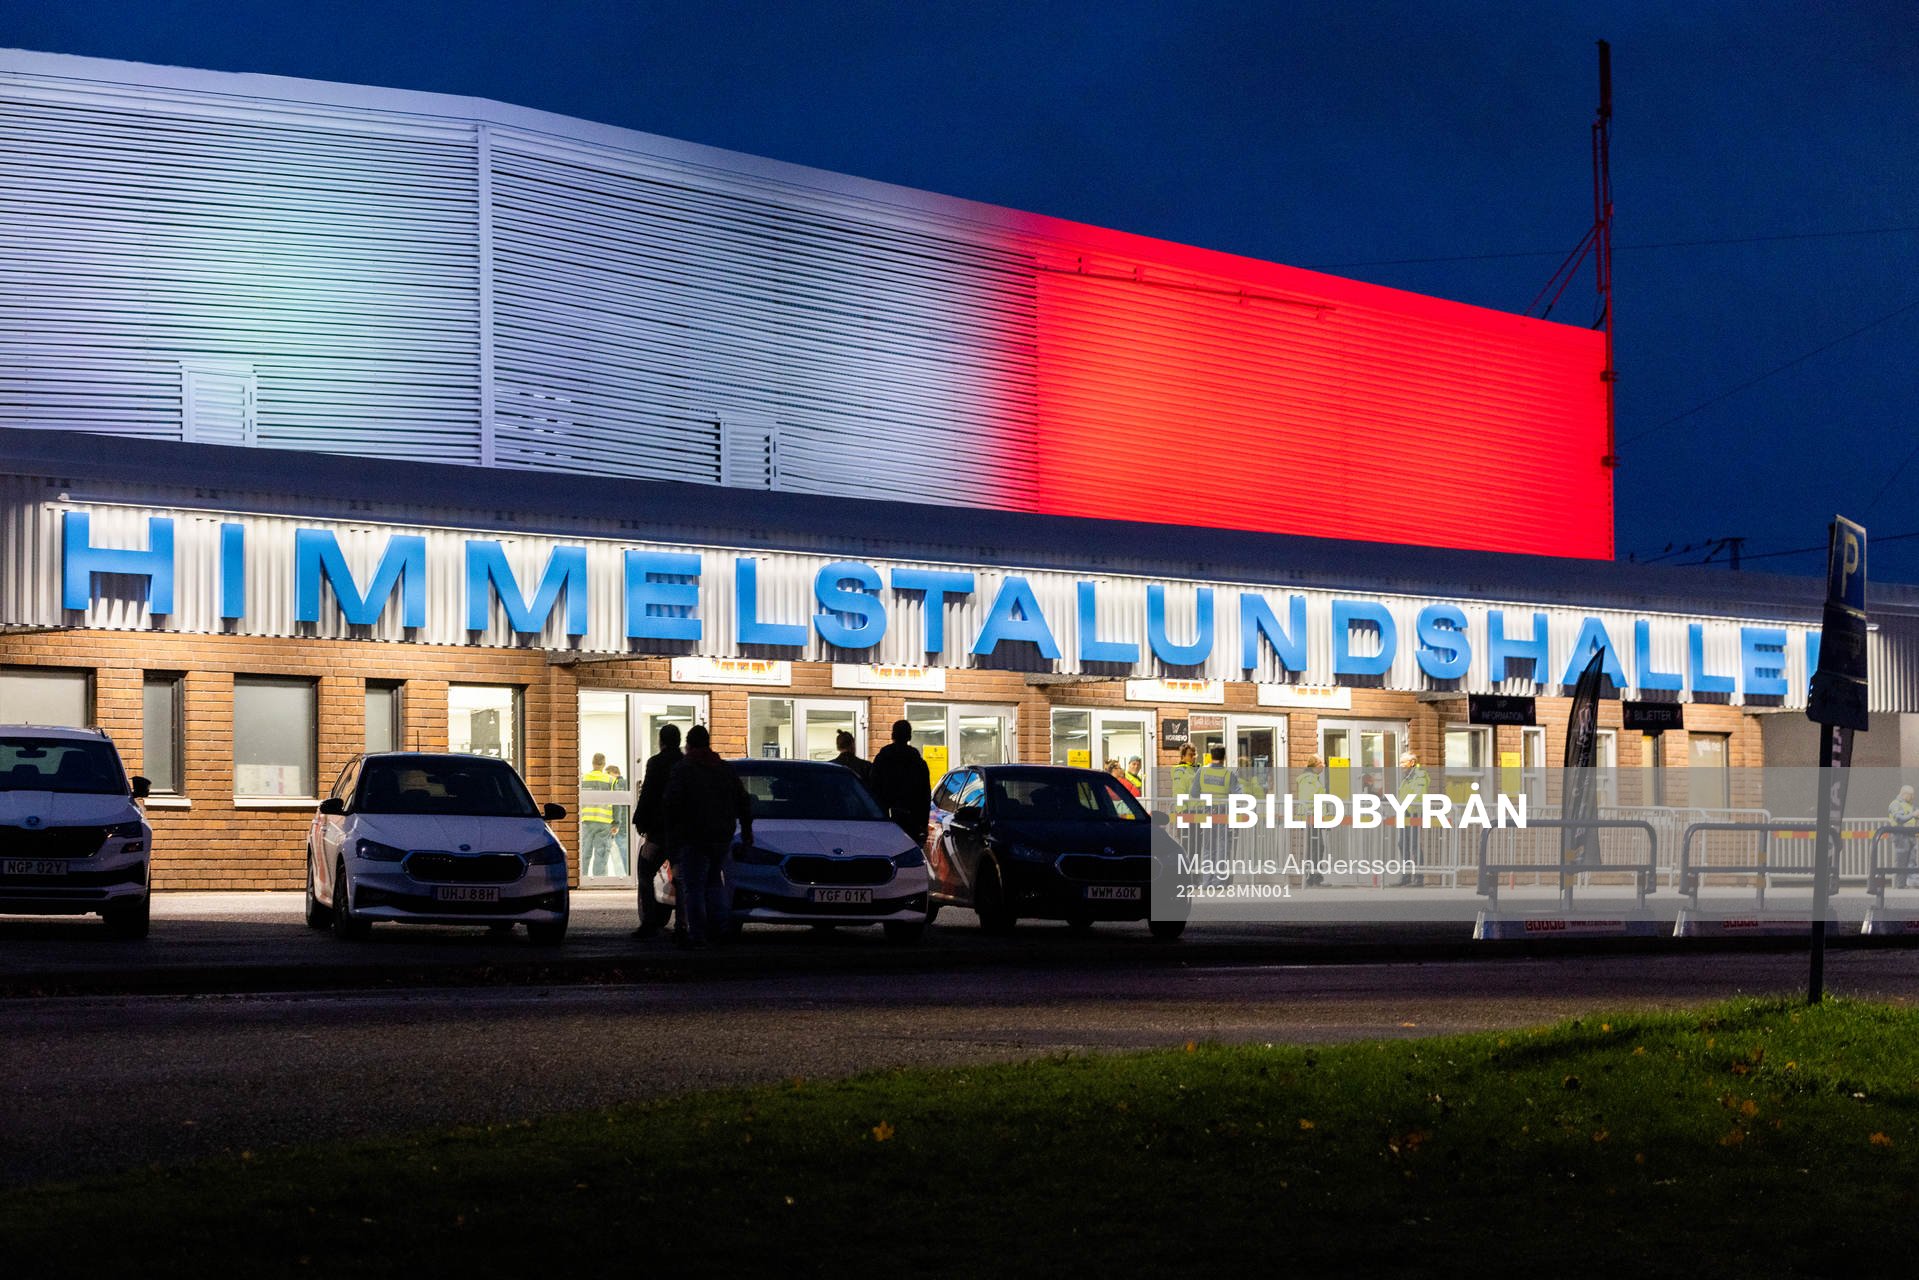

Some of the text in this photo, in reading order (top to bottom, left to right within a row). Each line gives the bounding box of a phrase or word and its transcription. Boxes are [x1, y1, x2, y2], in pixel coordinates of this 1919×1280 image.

[1841, 533, 1859, 598] P
[62, 511, 1823, 696] HIMMELSTALUNDSHALLE
[1481, 711, 1525, 721] INFORMATION
[1633, 710, 1672, 721] BILJETTER
[8, 861, 62, 873] NGP 02Y
[442, 888, 495, 900] UHJ 88H
[818, 890, 867, 902] YGF 01K
[1091, 887, 1137, 898] WWM 60K
